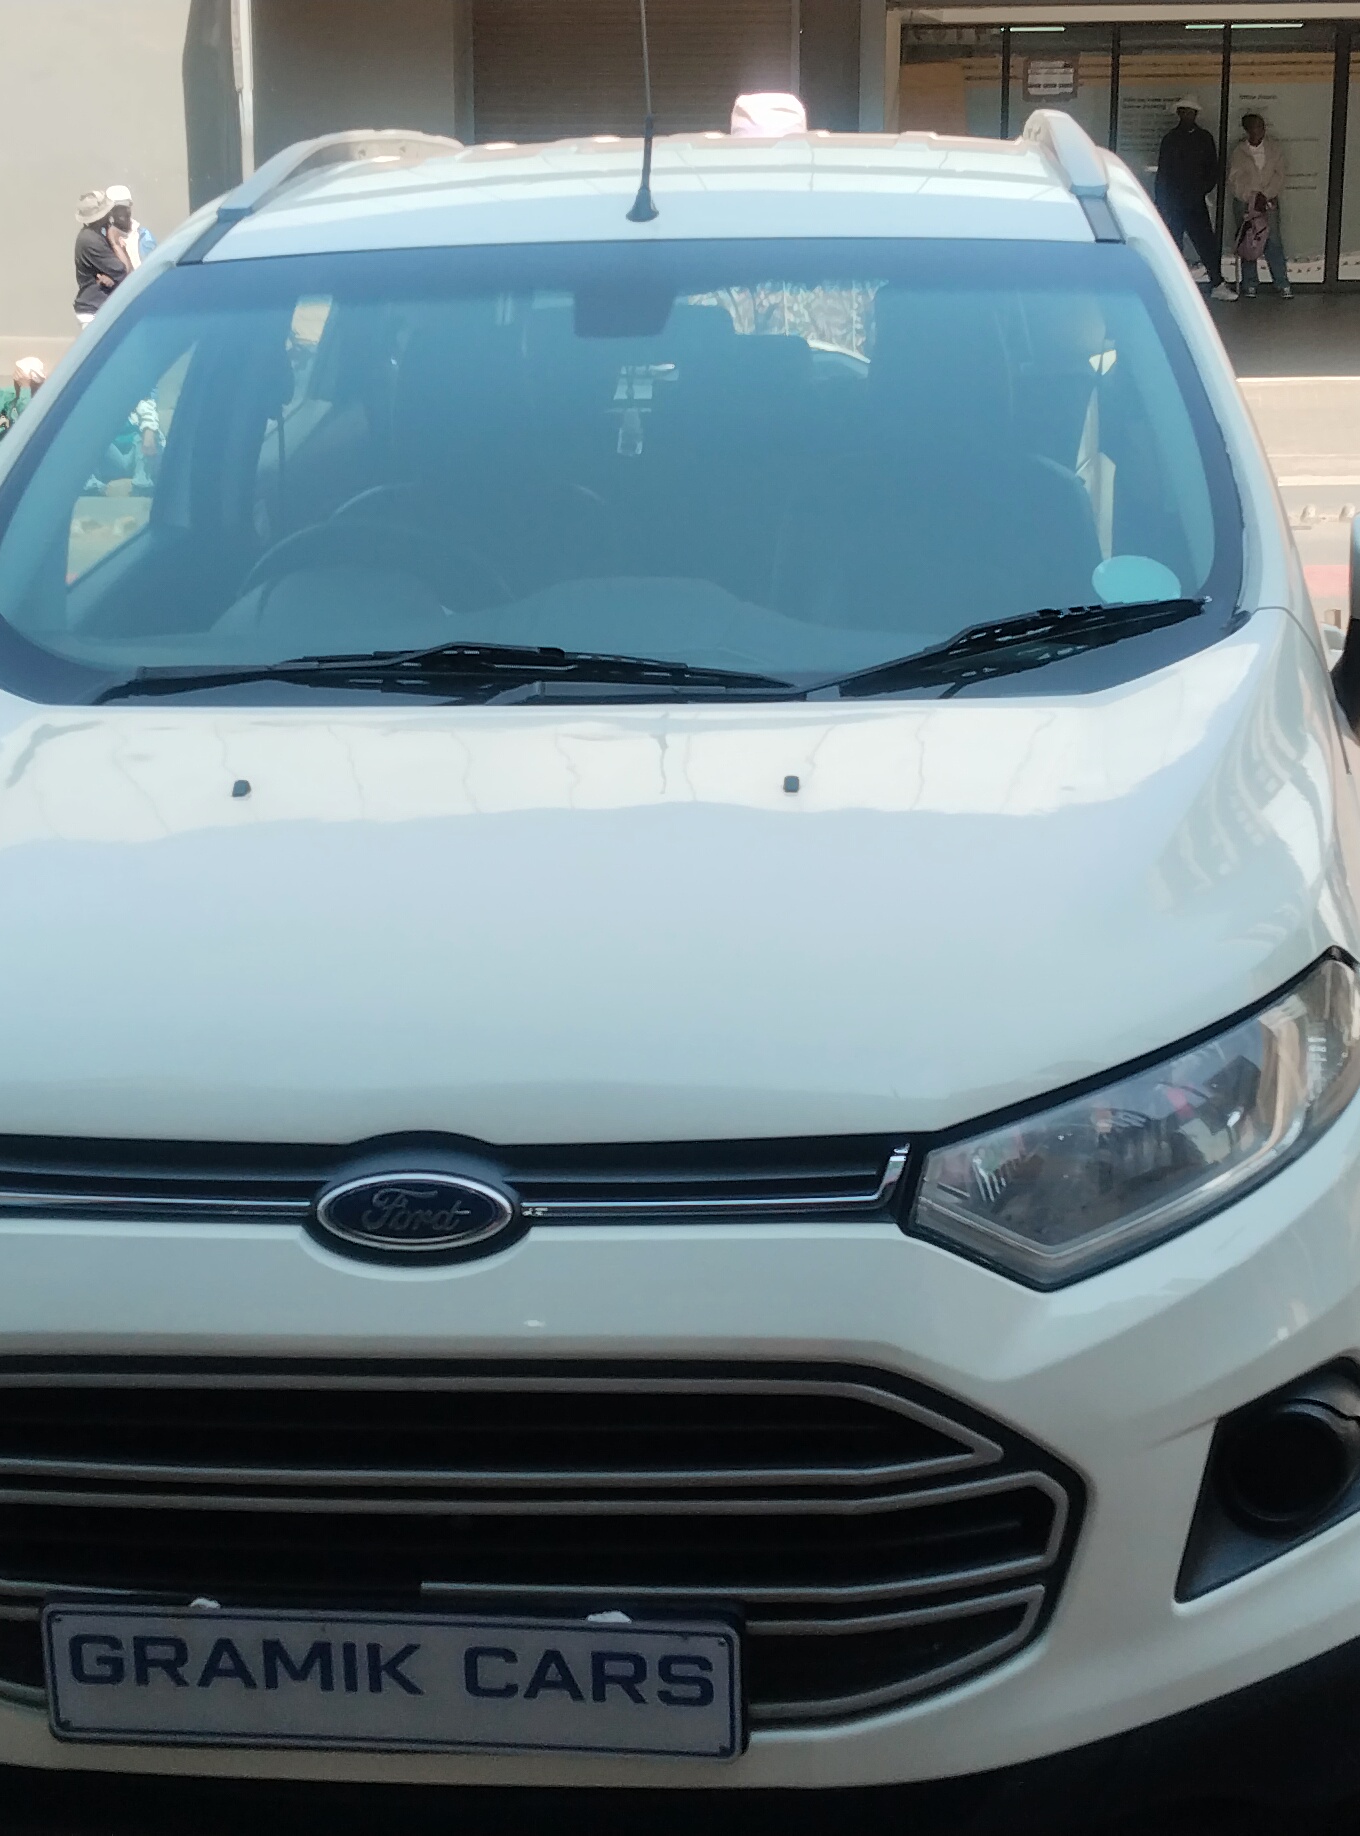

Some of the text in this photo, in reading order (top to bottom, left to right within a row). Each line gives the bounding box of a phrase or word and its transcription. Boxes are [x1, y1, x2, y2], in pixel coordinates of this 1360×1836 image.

[361, 1188, 471, 1230] Ford
[69, 1634, 716, 1707] GRAMIK CARS
